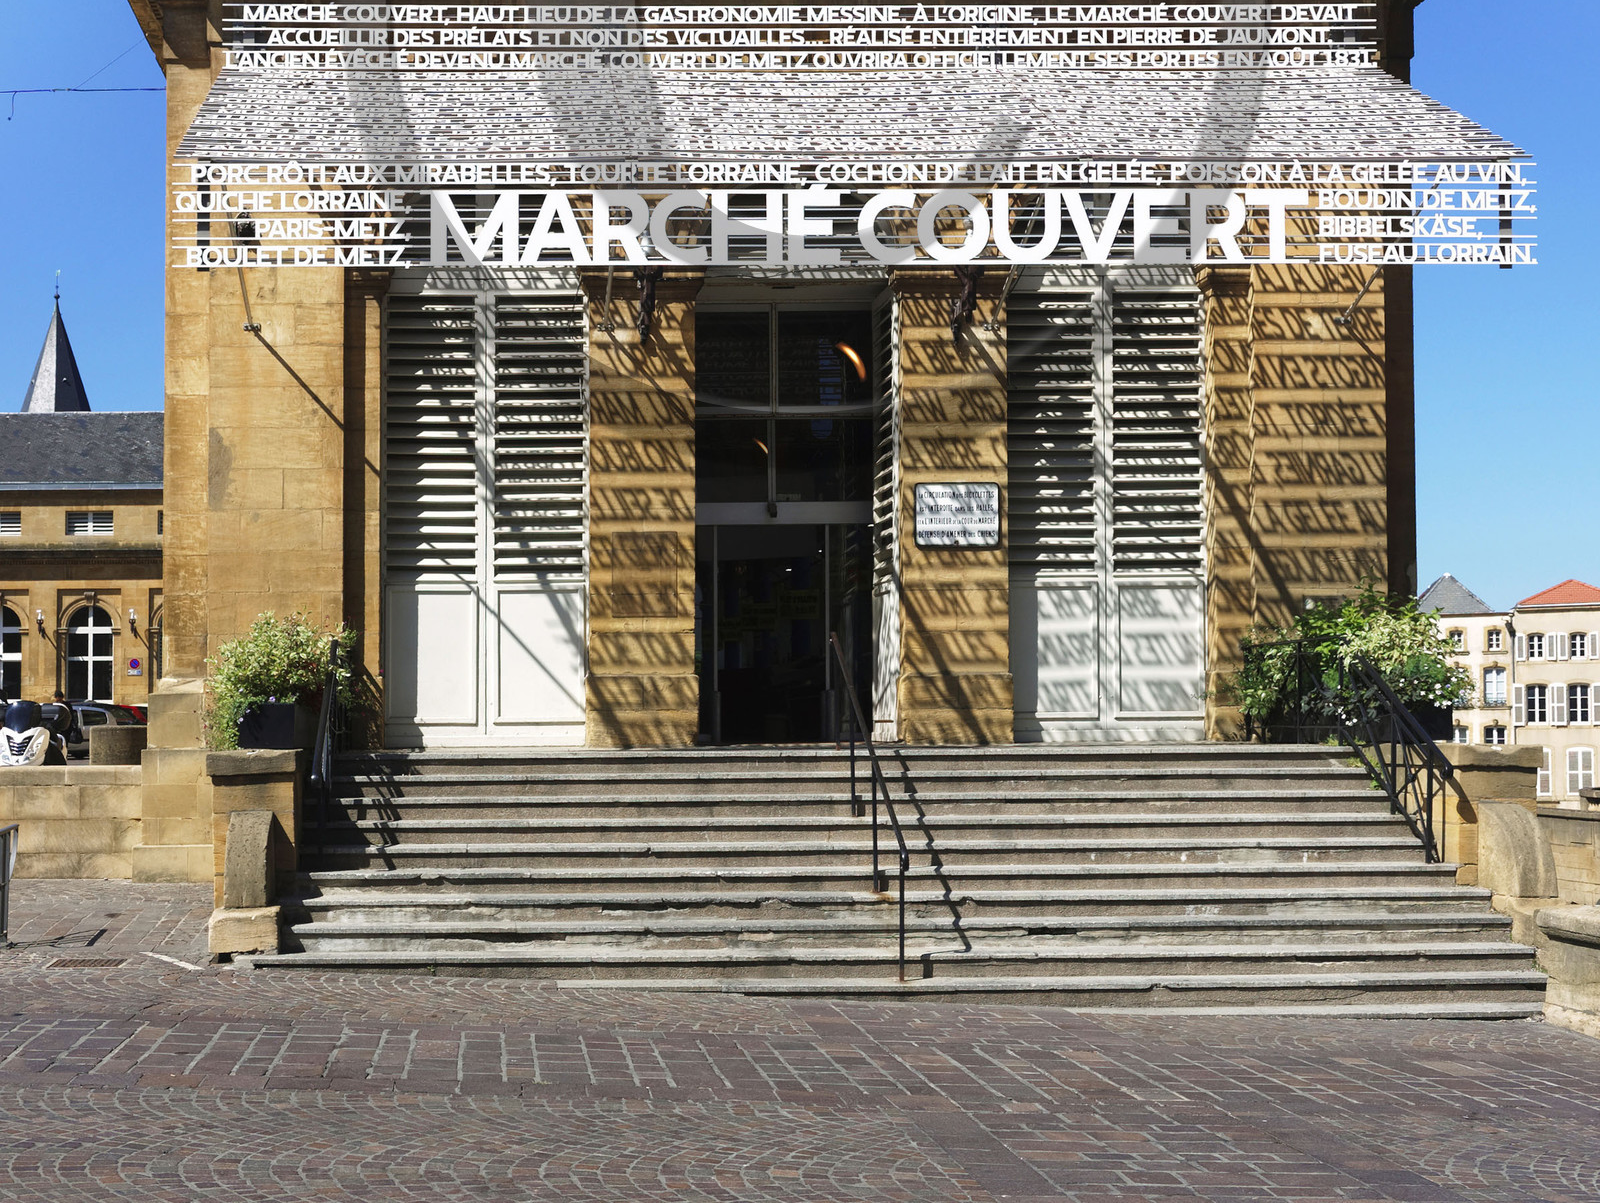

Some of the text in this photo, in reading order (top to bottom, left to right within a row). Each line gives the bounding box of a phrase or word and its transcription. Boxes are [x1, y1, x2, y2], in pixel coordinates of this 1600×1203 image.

[244, 2, 338, 21] MARCHÉ
[343, 5, 448, 25] COUVERT,
[457, 6, 519, 22] HAUT
[525, 6, 571, 22] LIEU
[578, 6, 606, 22] DE
[611, 6, 638, 22] LA
[644, 6, 801, 22] GASTRONOMIE
[912, 3, 929, 22] À
[1046, 6, 1070, 22] LE
[1076, 3, 1168, 22] MARCHÉ
[1174, 6, 1276, 22] COUVERT
[1281, 5, 1358, 21] DEVAIT
[267, 26, 1332, 46] ACCUEILLIR DES PRÉLATS ET NON DES VICTUAILLES... RÉALISÉ ENTIÈREMENT EN PIERRE DE JAUMONT.
[325, 49, 407, 68] ÉVÊCHÉ
[415, 52, 504, 68] DEVENU
[510, 50, 602, 68] MARCHÉ
[611, 52, 706, 68] COUVERT
[716, 52, 746, 68] DE
[749, 52, 806, 68] METZ
[812, 52, 908, 68] OUVRIRA
[913, 52, 1090, 68] OFFICIELLEMENT
[1094, 52, 1132, 68] SES
[1138, 52, 1218, 68] PORTES
[1224, 52, 1254, 67] EN
[1260, 47, 1318, 67] AOÛT
[1322, 51, 1376, 67] 1831.
[190, 159, 1526, 186] PORC RÔTI AUX MIRABELLES, TOURTE LORRAINE, COCHON DE LAIT EN GELÉE, POISSON À LA GELÉE AU VIN,
[176, 192, 411, 214] QUICHE LORRAINE,
[1319, 190, 1536, 213] BOUDIN DE METZ,
[256, 220, 411, 241] PARIS-METZ,
[431, 184, 1308, 265] MARCHÉ COUVERT
[1318, 214, 1482, 240] BIBBELSKÄSE,
[186, 246, 411, 268] BOULET DE METZ,
[1320, 244, 1537, 263] FUSEAU LORRAIN.
[924, 491, 956, 499] CIRCULATION
[928, 504, 953, 512] INTERDITE
[976, 504, 994, 512] HALLES
[977, 530, 996, 538] CHIENS
